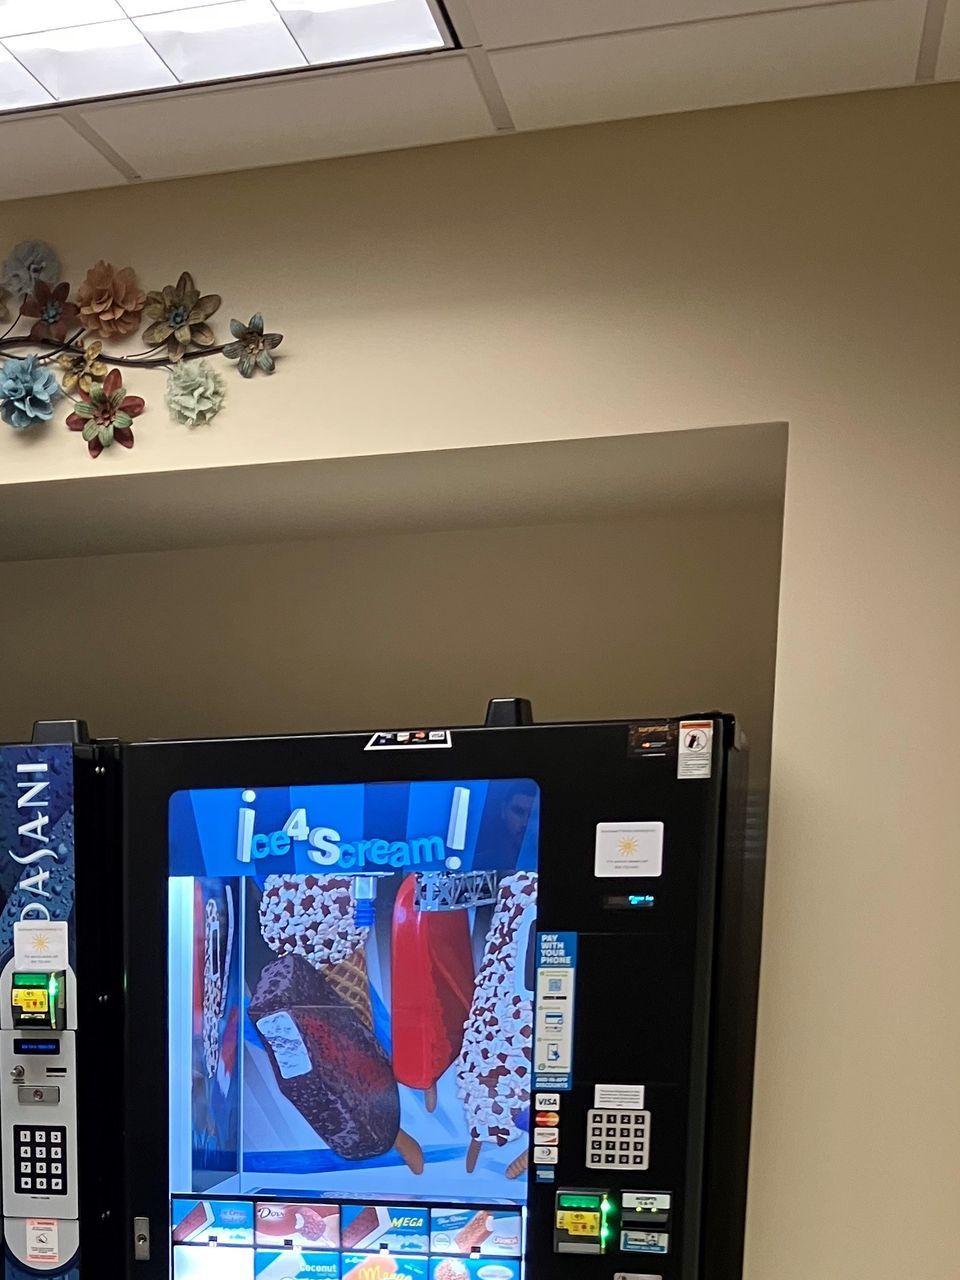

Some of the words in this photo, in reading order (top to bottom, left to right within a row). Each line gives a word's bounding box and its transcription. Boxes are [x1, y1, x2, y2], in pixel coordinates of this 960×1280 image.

[282, 808, 309, 841] 4
[8, 763, 59, 922] DASANI
[541, 956, 571, 964] PHONE
[390, 1216, 424, 1228] MEGA
[299, 1263, 337, 1273] Coconut
